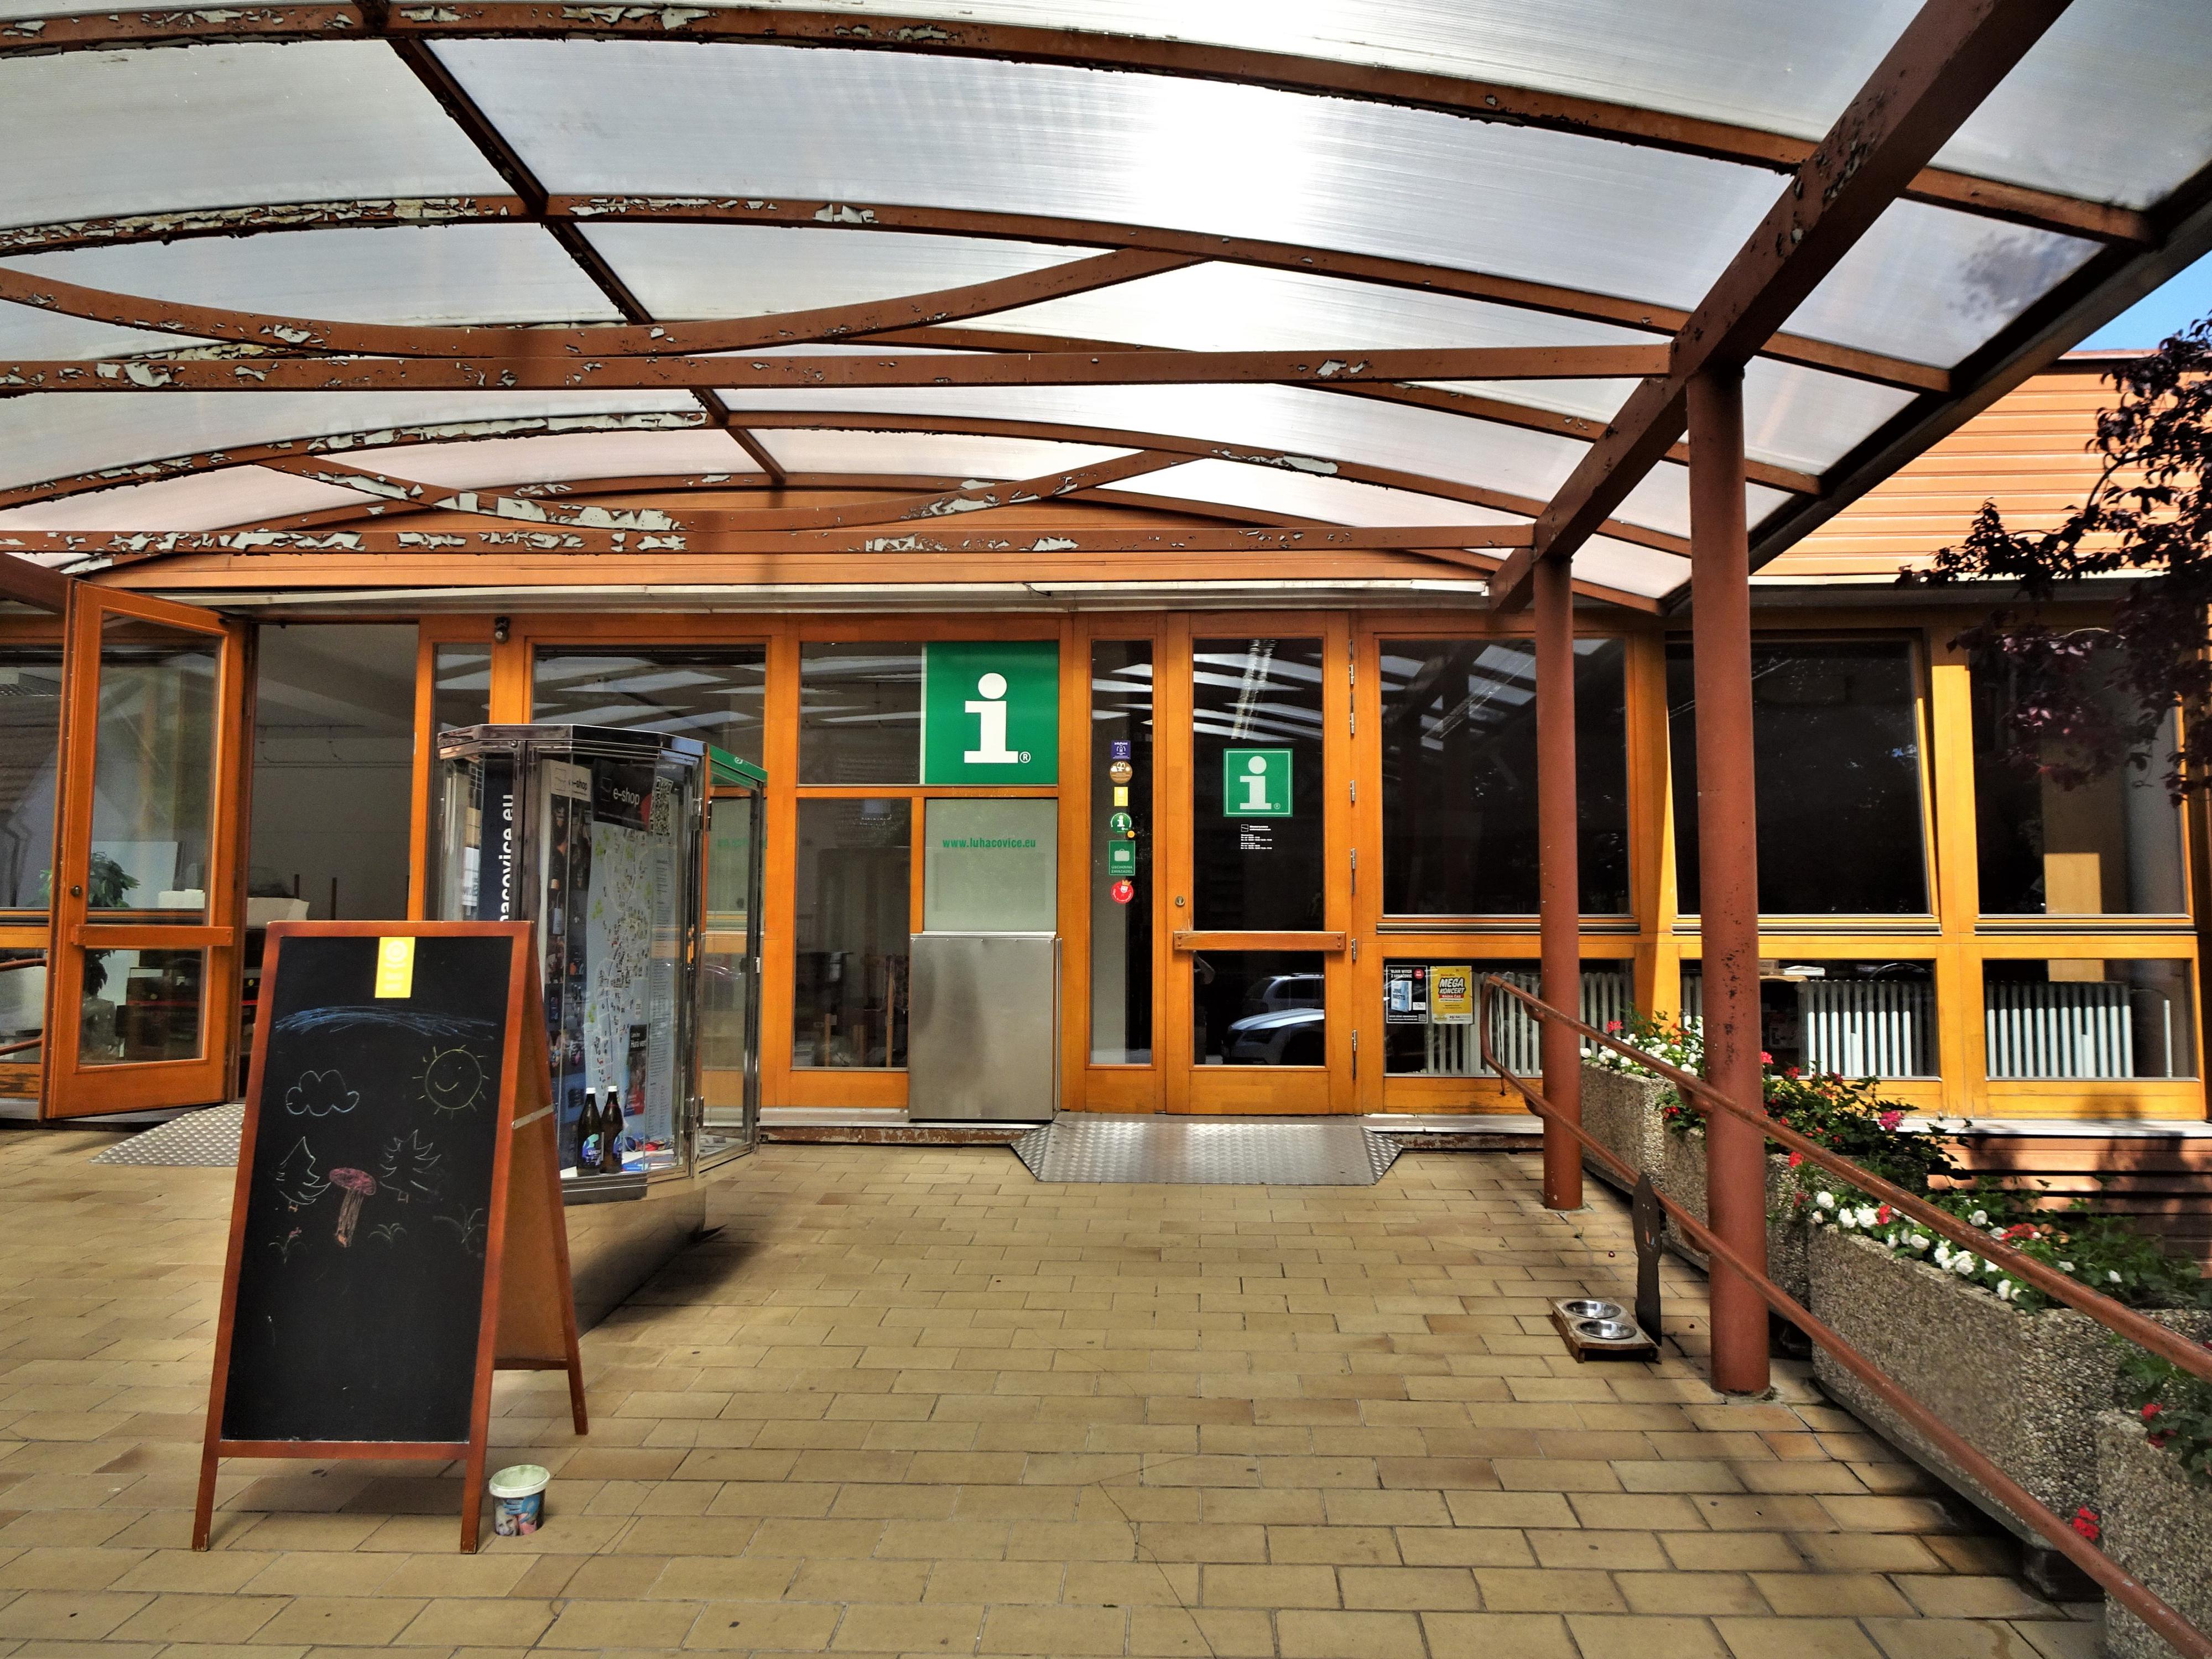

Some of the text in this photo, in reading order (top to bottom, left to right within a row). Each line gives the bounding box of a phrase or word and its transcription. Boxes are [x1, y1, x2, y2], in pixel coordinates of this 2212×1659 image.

[964, 672, 1018, 763] i
[1240, 755, 1272, 810] i
[613, 787, 640, 808] e-shop
[942, 837, 1036, 848] www.luhacovice.eu
[1439, 978, 1464, 988] MEGA
